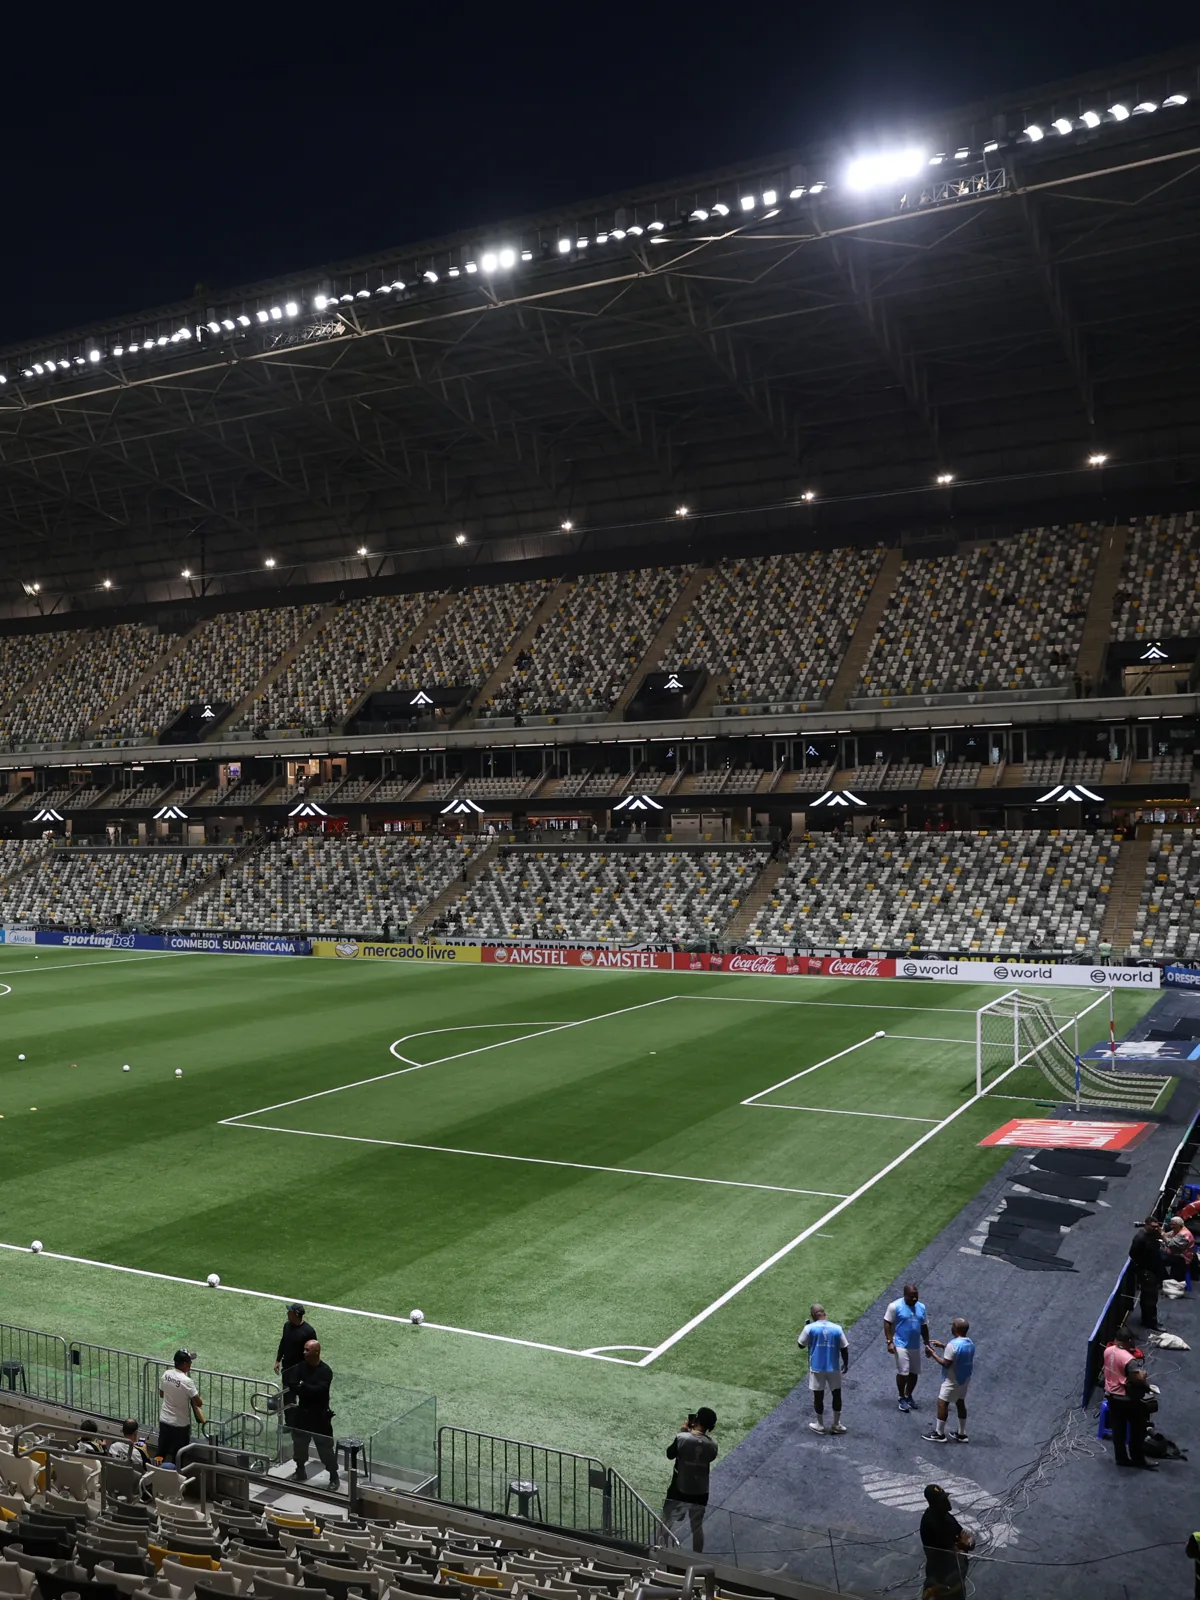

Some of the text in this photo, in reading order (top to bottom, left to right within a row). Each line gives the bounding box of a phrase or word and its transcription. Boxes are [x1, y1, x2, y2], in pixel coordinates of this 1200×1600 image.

[62, 934, 135, 948] sportingbet
[171, 938, 295, 952] CONMEBOL SUDAMERICANA
[363, 945, 456, 960] mercado livre
[509, 950, 568, 965] AMSTEL
[596, 952, 658, 968] AMSTEL
[729, 955, 777, 973] Coca-Cola
[828, 958, 881, 976] Coca-Cola
[919, 965, 958, 975] world
[1010, 968, 1052, 979] world
[1108, 971, 1153, 983] world
[1167, 972, 1174, 981] O
